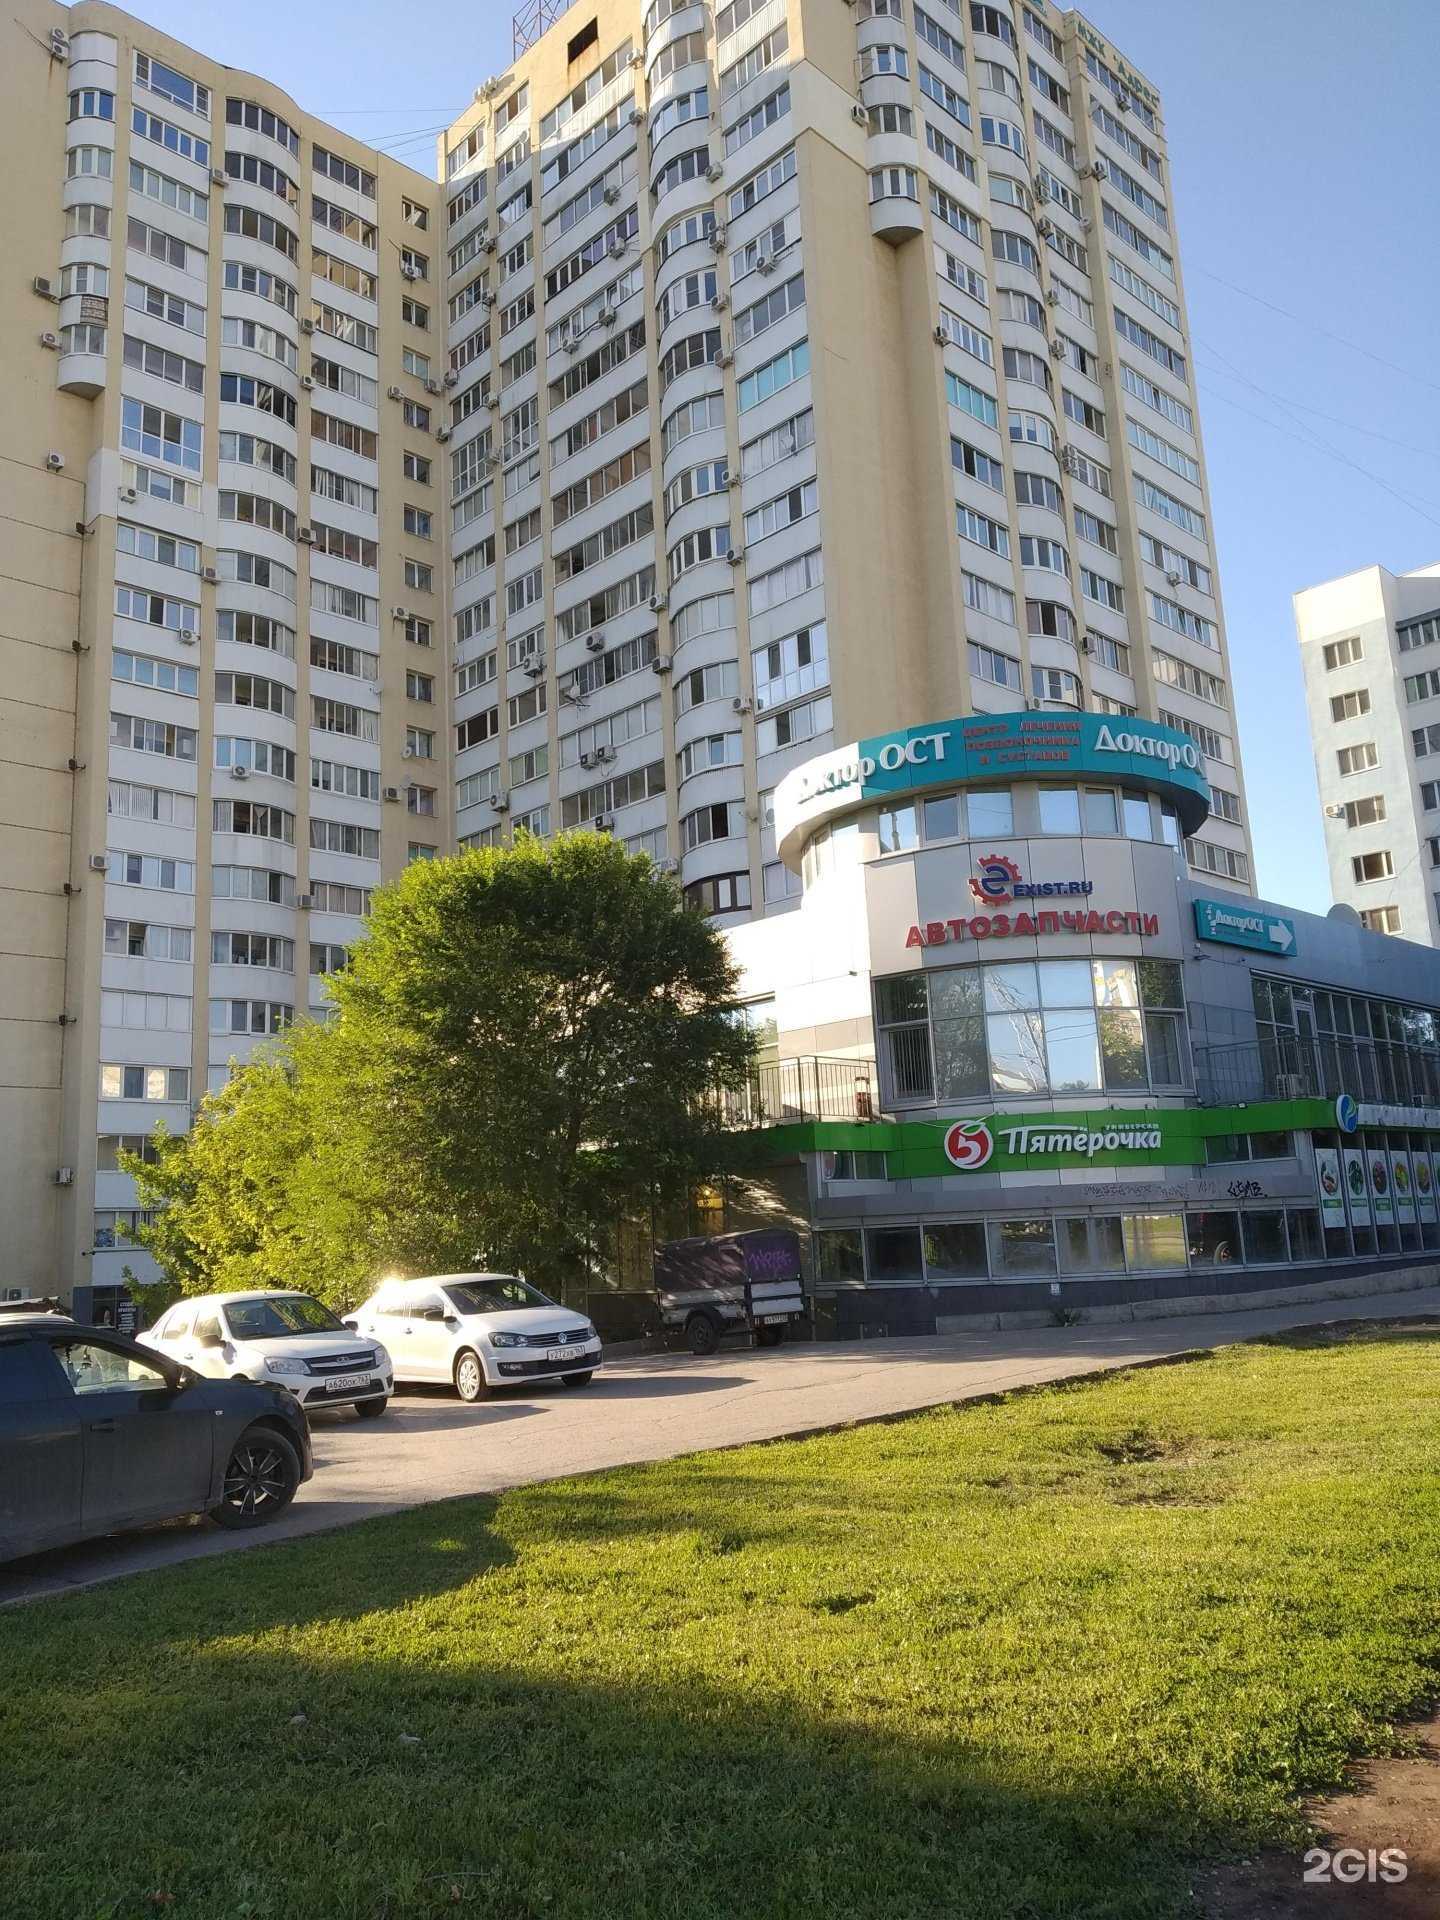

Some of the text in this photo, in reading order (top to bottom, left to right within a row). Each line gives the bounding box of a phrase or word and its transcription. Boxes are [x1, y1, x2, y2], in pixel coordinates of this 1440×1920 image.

[1013, 880, 1093, 897] EXIST.RU
[905, 910, 1160, 948] АВТОЗАПЧАСТИ
[998, 1124, 1162, 1157] Пятёрочка
